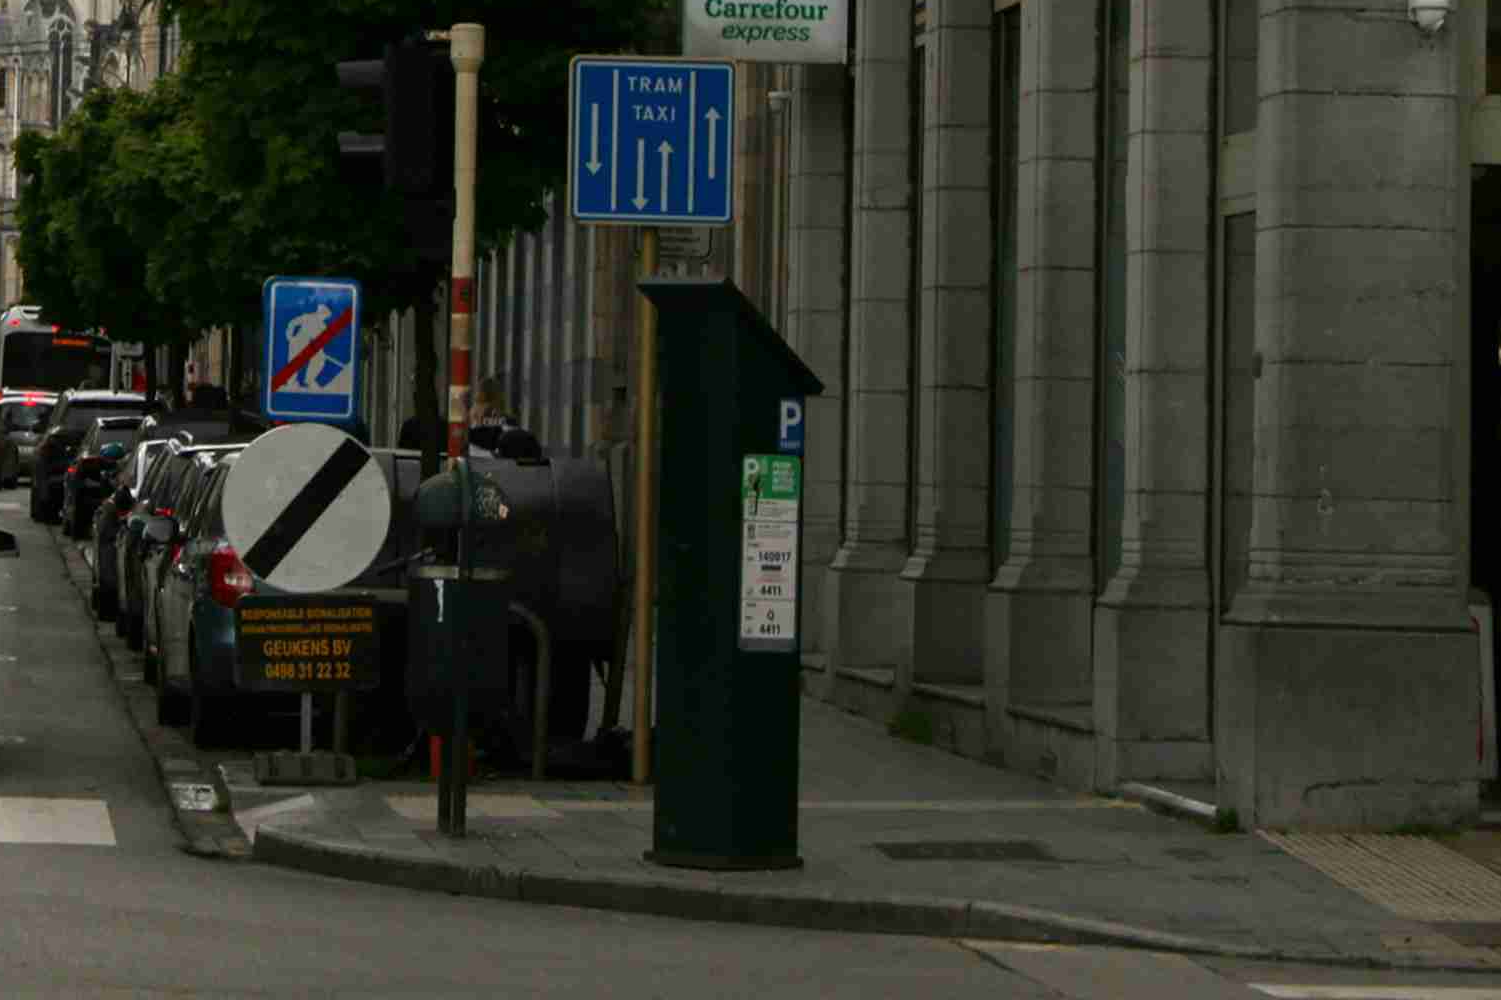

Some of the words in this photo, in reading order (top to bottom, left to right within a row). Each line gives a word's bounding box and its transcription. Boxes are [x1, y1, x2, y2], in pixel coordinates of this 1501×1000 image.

[721, 23, 811, 44] express
[627, 75, 684, 96] TRAM
[632, 104, 676, 123] TAXI
[779, 399, 803, 440] P
[262, 639, 330, 657] GEUKENS
